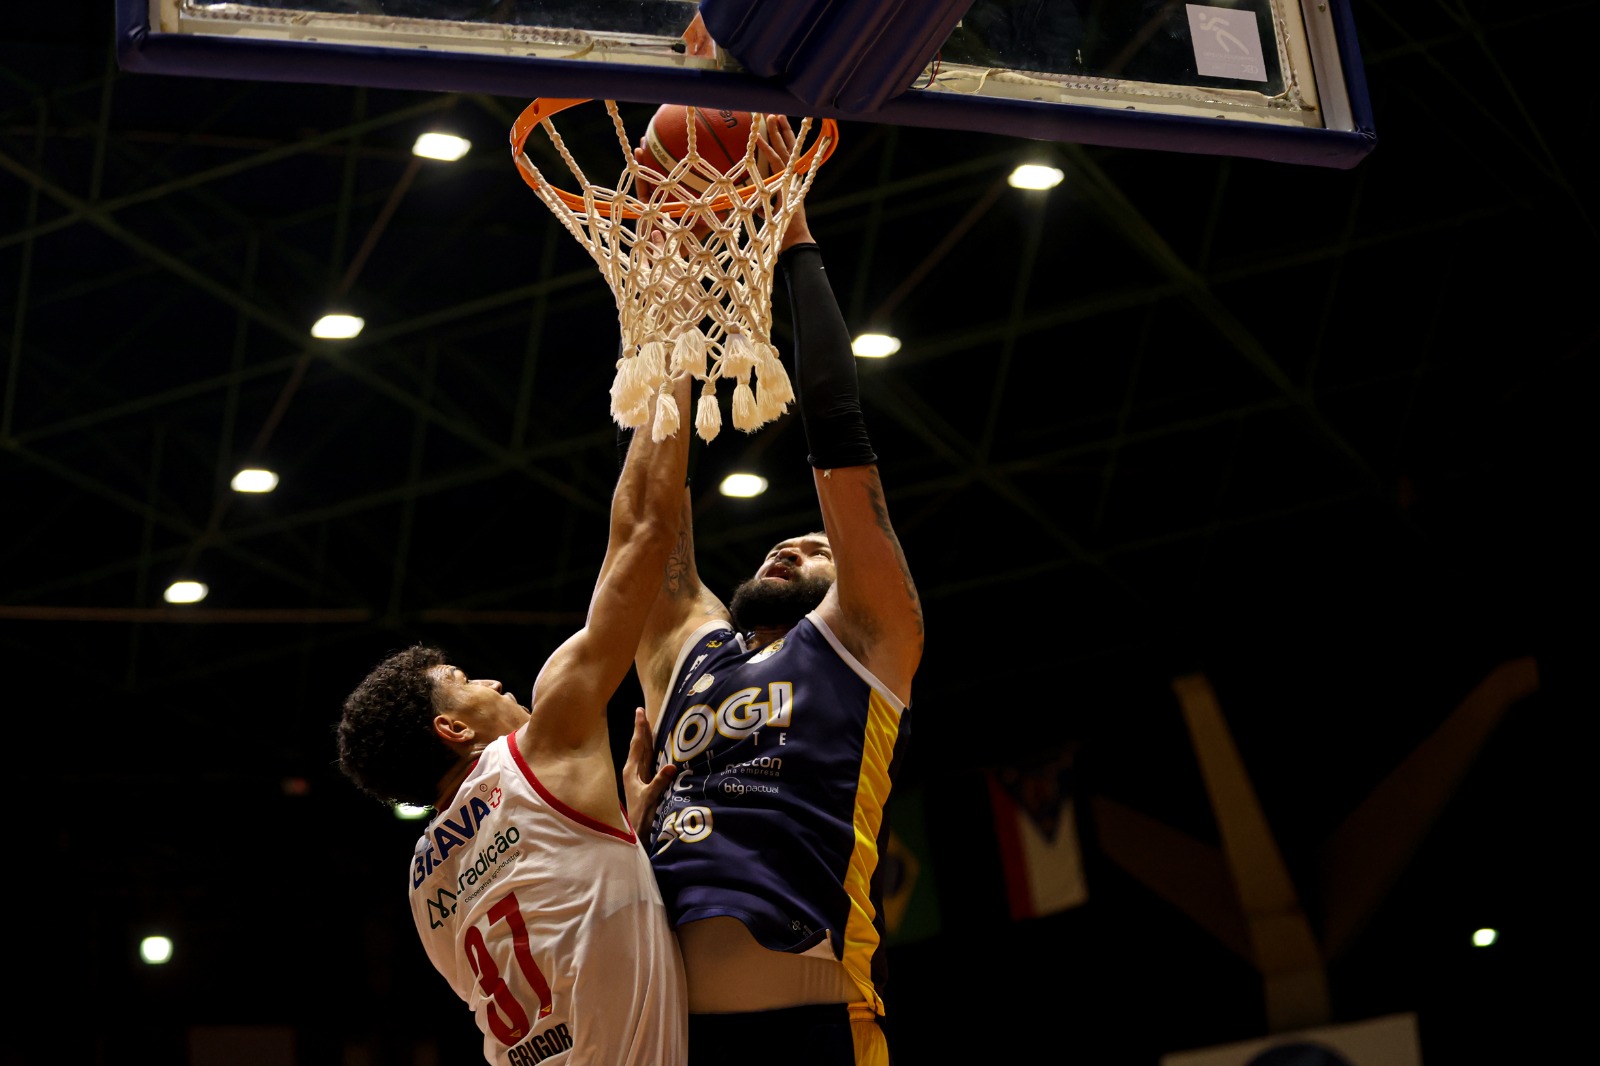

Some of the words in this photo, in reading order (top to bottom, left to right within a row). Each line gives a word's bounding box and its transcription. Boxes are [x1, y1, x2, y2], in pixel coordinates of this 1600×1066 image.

[740, 767, 780, 777] empresa
[413, 796, 491, 890] BRAVA
[455, 826, 521, 896] radição
[464, 878, 493, 903] cooperativa
[491, 850, 521, 880] agroindustrial
[464, 891, 553, 1047] 37
[508, 1022, 573, 1066] GRIGOR
